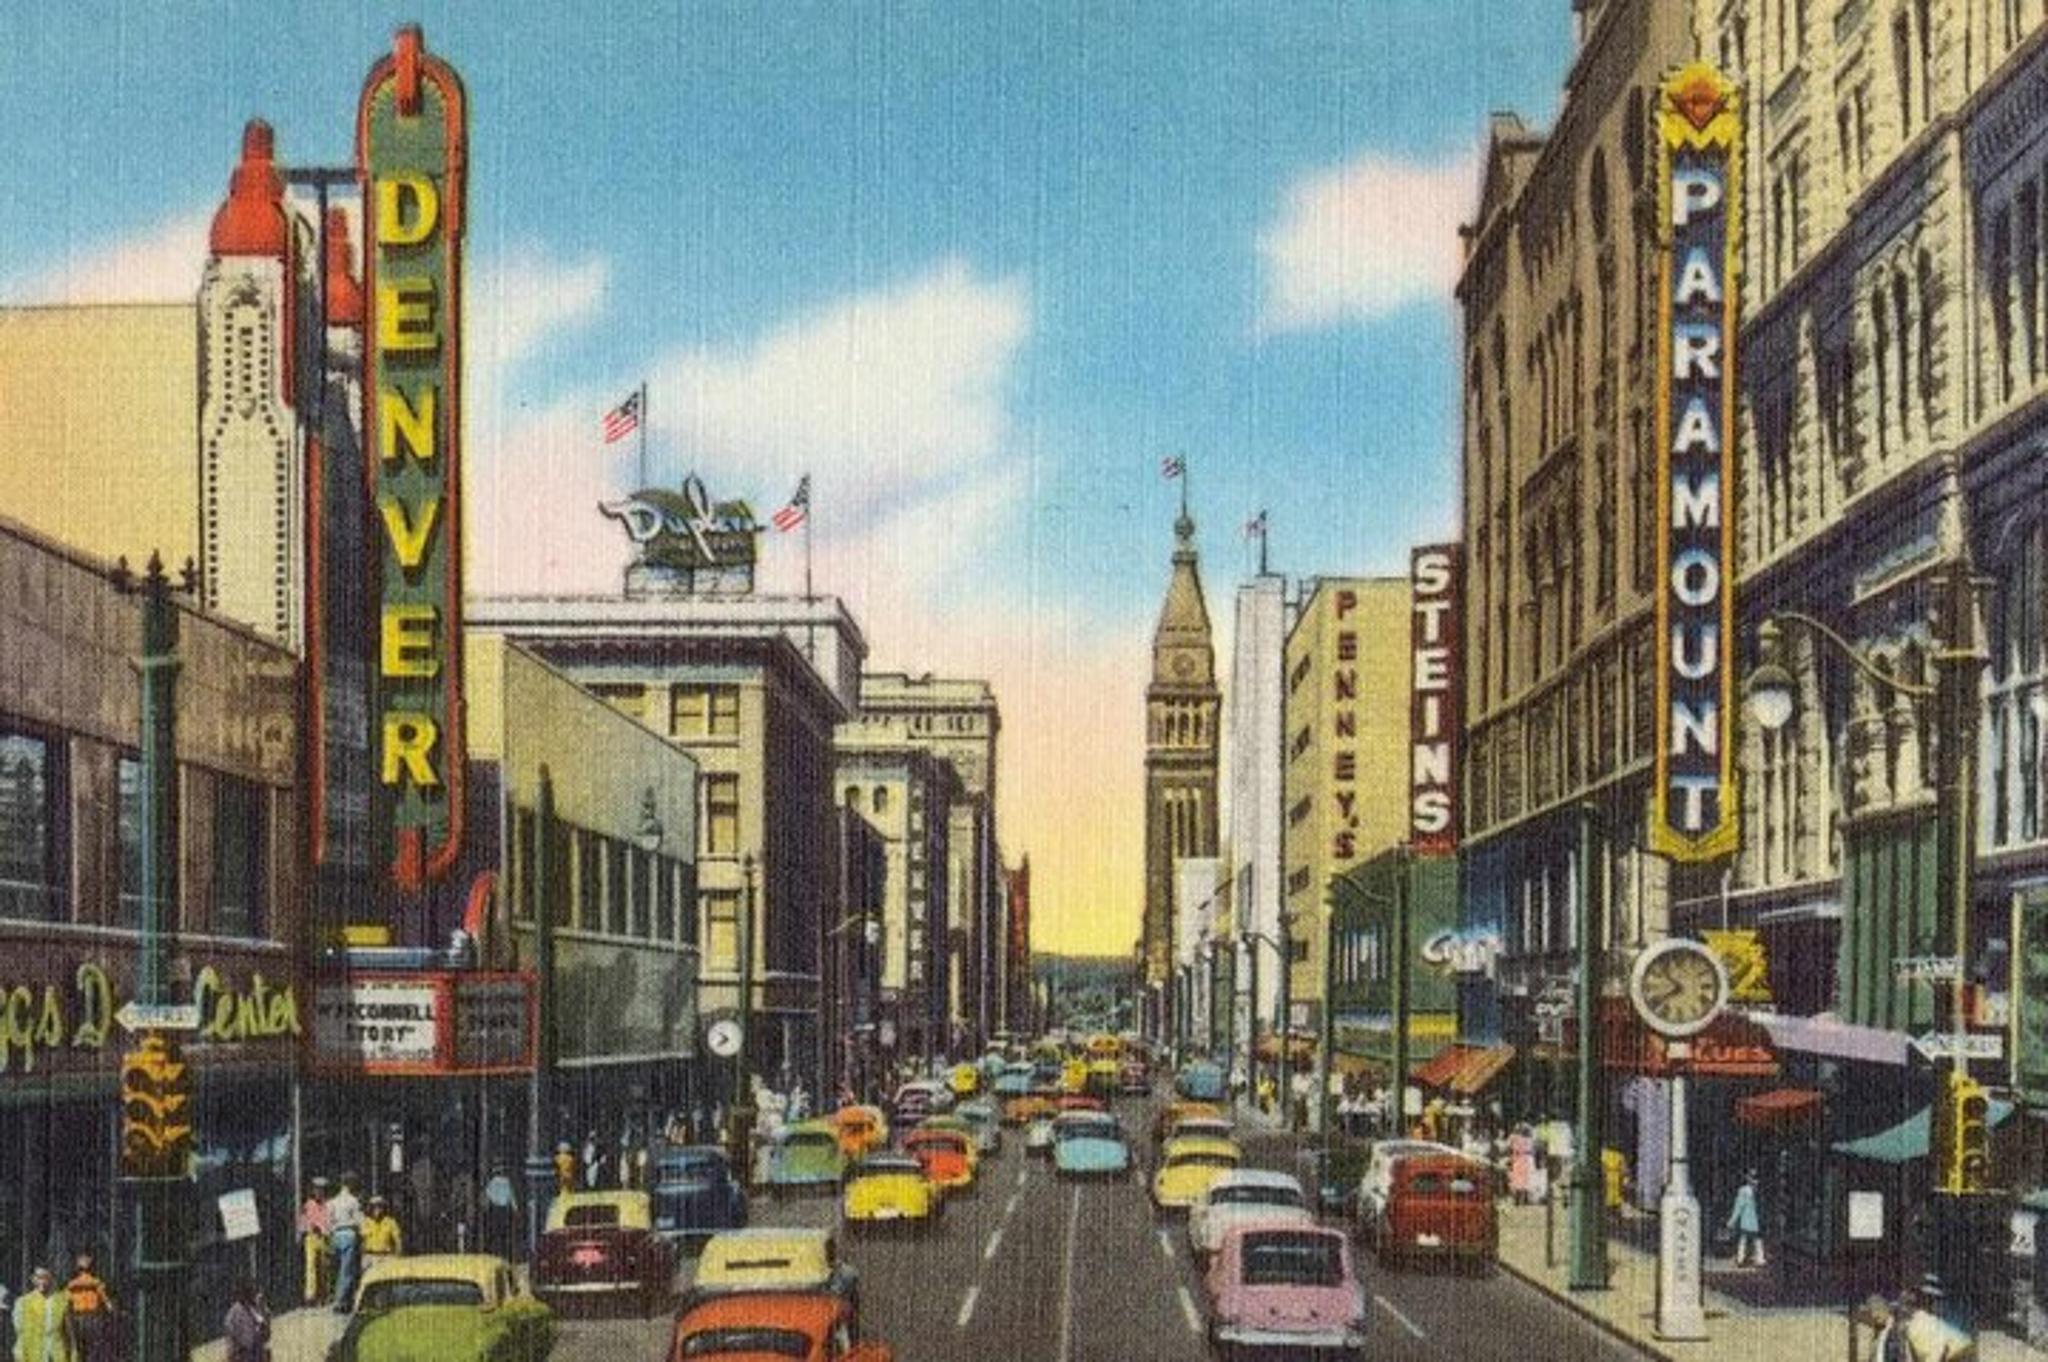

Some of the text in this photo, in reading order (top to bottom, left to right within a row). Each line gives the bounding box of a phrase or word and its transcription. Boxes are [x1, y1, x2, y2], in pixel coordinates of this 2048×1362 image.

[377, 177, 441, 786] DENVER
[1413, 554, 1451, 833] STEINS
[1671, 166, 1721, 830] PARAMOUNT
[1334, 590, 1359, 859] PENNEY'S
